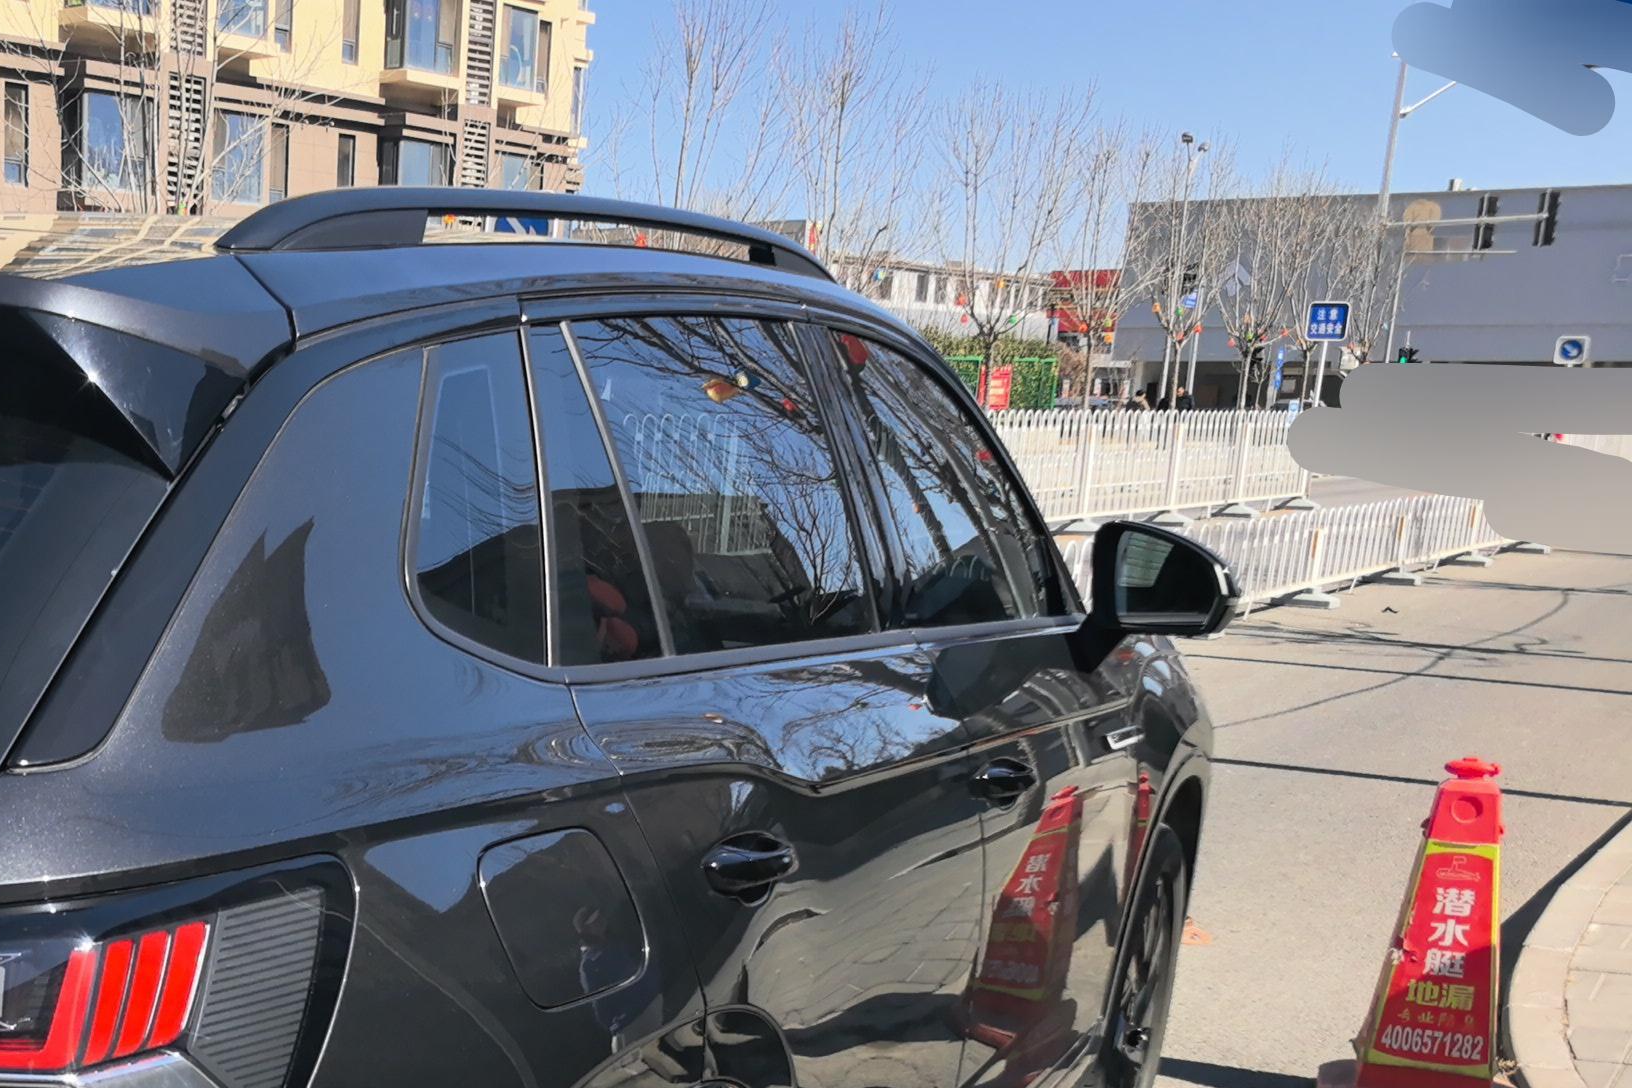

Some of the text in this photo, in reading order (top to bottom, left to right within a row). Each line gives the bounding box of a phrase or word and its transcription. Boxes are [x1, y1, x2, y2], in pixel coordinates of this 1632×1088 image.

[1423, 887, 1475, 978] 潜水艇
[1405, 979, 1475, 1011] 地漏
[1380, 1024, 1484, 1060] 4006571282
